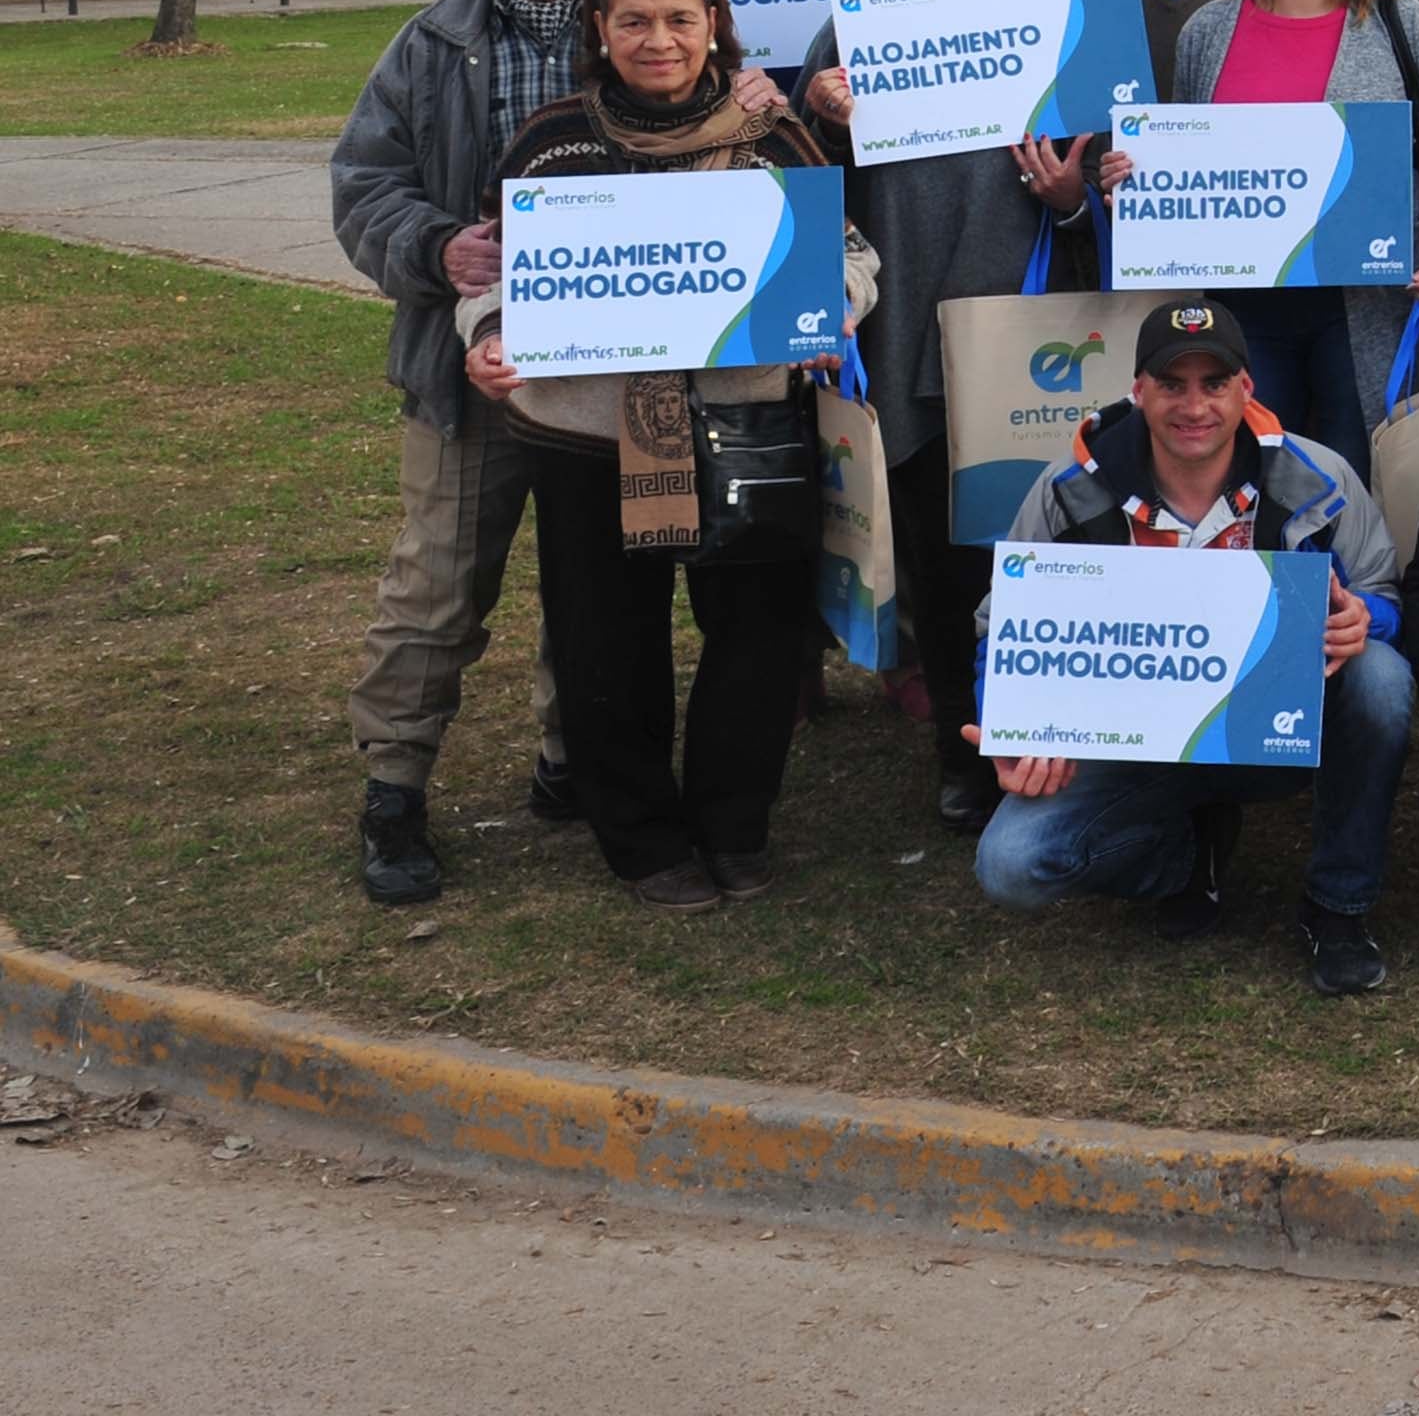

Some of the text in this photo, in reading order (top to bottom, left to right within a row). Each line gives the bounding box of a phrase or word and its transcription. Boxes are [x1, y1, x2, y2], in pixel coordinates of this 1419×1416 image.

[848, 24, 1041, 68] ALOJAMIENTO
[848, 53, 1023, 98] HABILITADO
[1118, 167, 1308, 192] ALOJAMIENTO
[1118, 195, 1286, 221] HABILITADO
[511, 239, 727, 271] ALOJAMIENTO
[510, 267, 747, 302] HOMOLOGADO
[997, 618, 1210, 649] ALOJAMIENTO
[993, 648, 1227, 683] HOMOLOGADO
